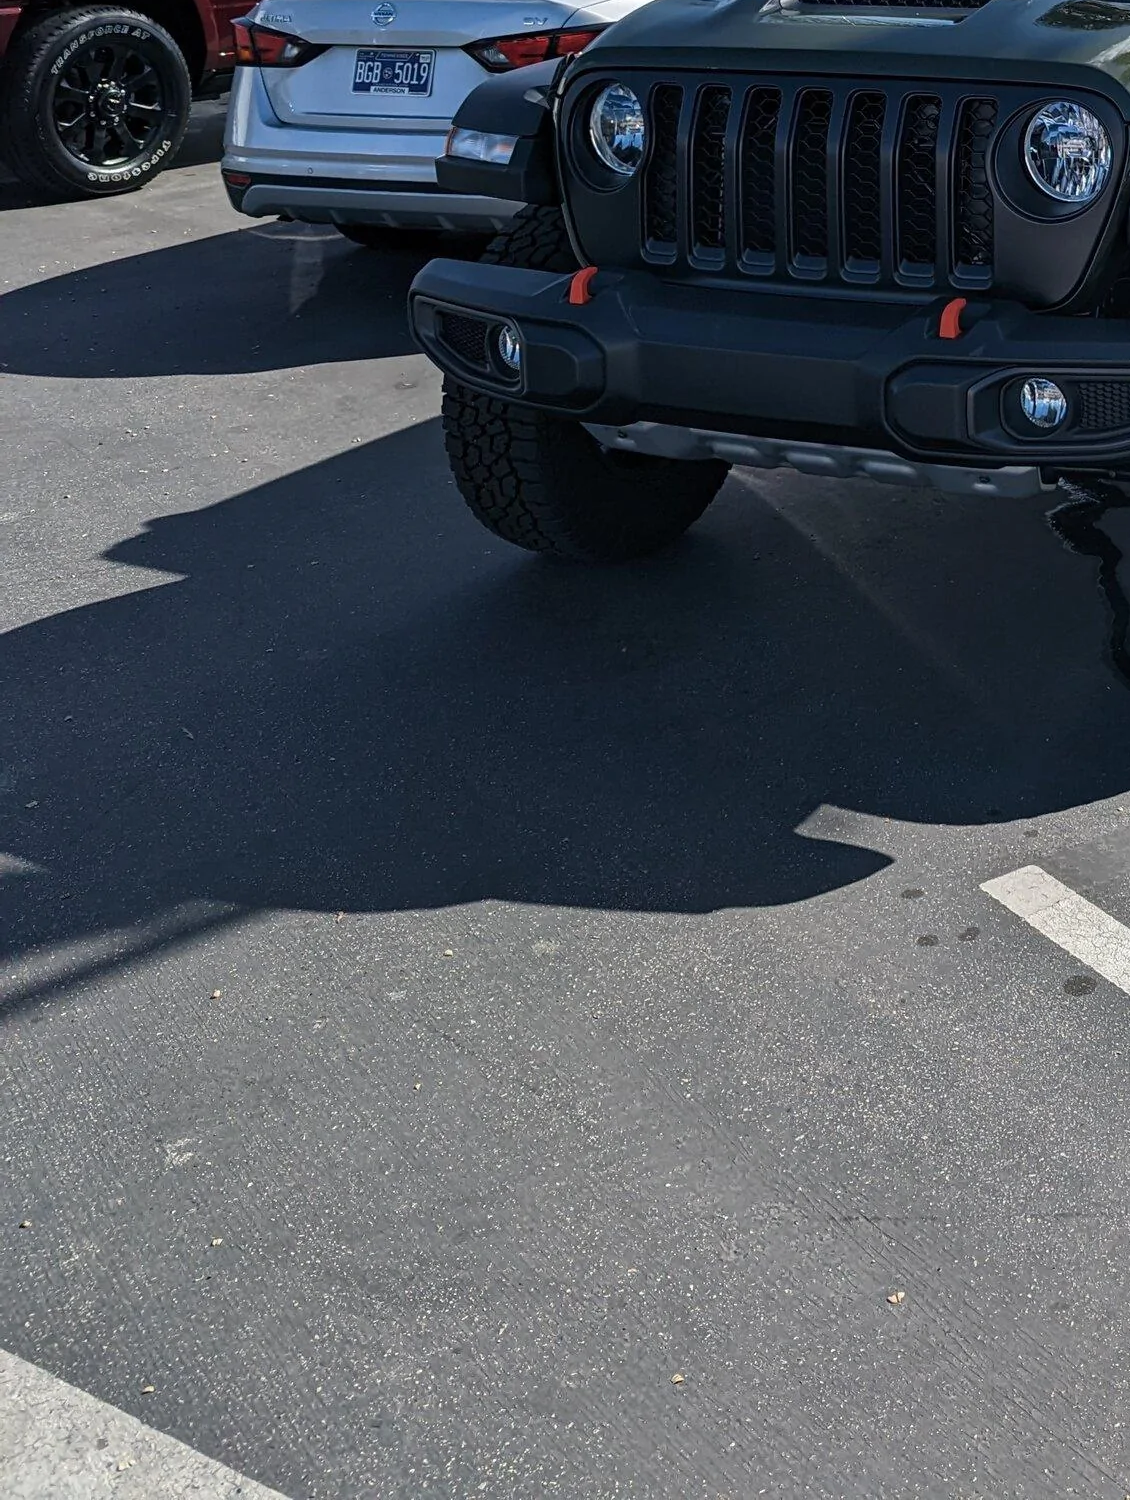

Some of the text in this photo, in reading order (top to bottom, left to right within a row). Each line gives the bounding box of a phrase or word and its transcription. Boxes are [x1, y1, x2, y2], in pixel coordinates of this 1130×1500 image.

[355, 61, 429, 85] BGB 5019
[373, 86, 406, 94] ANDERSON
